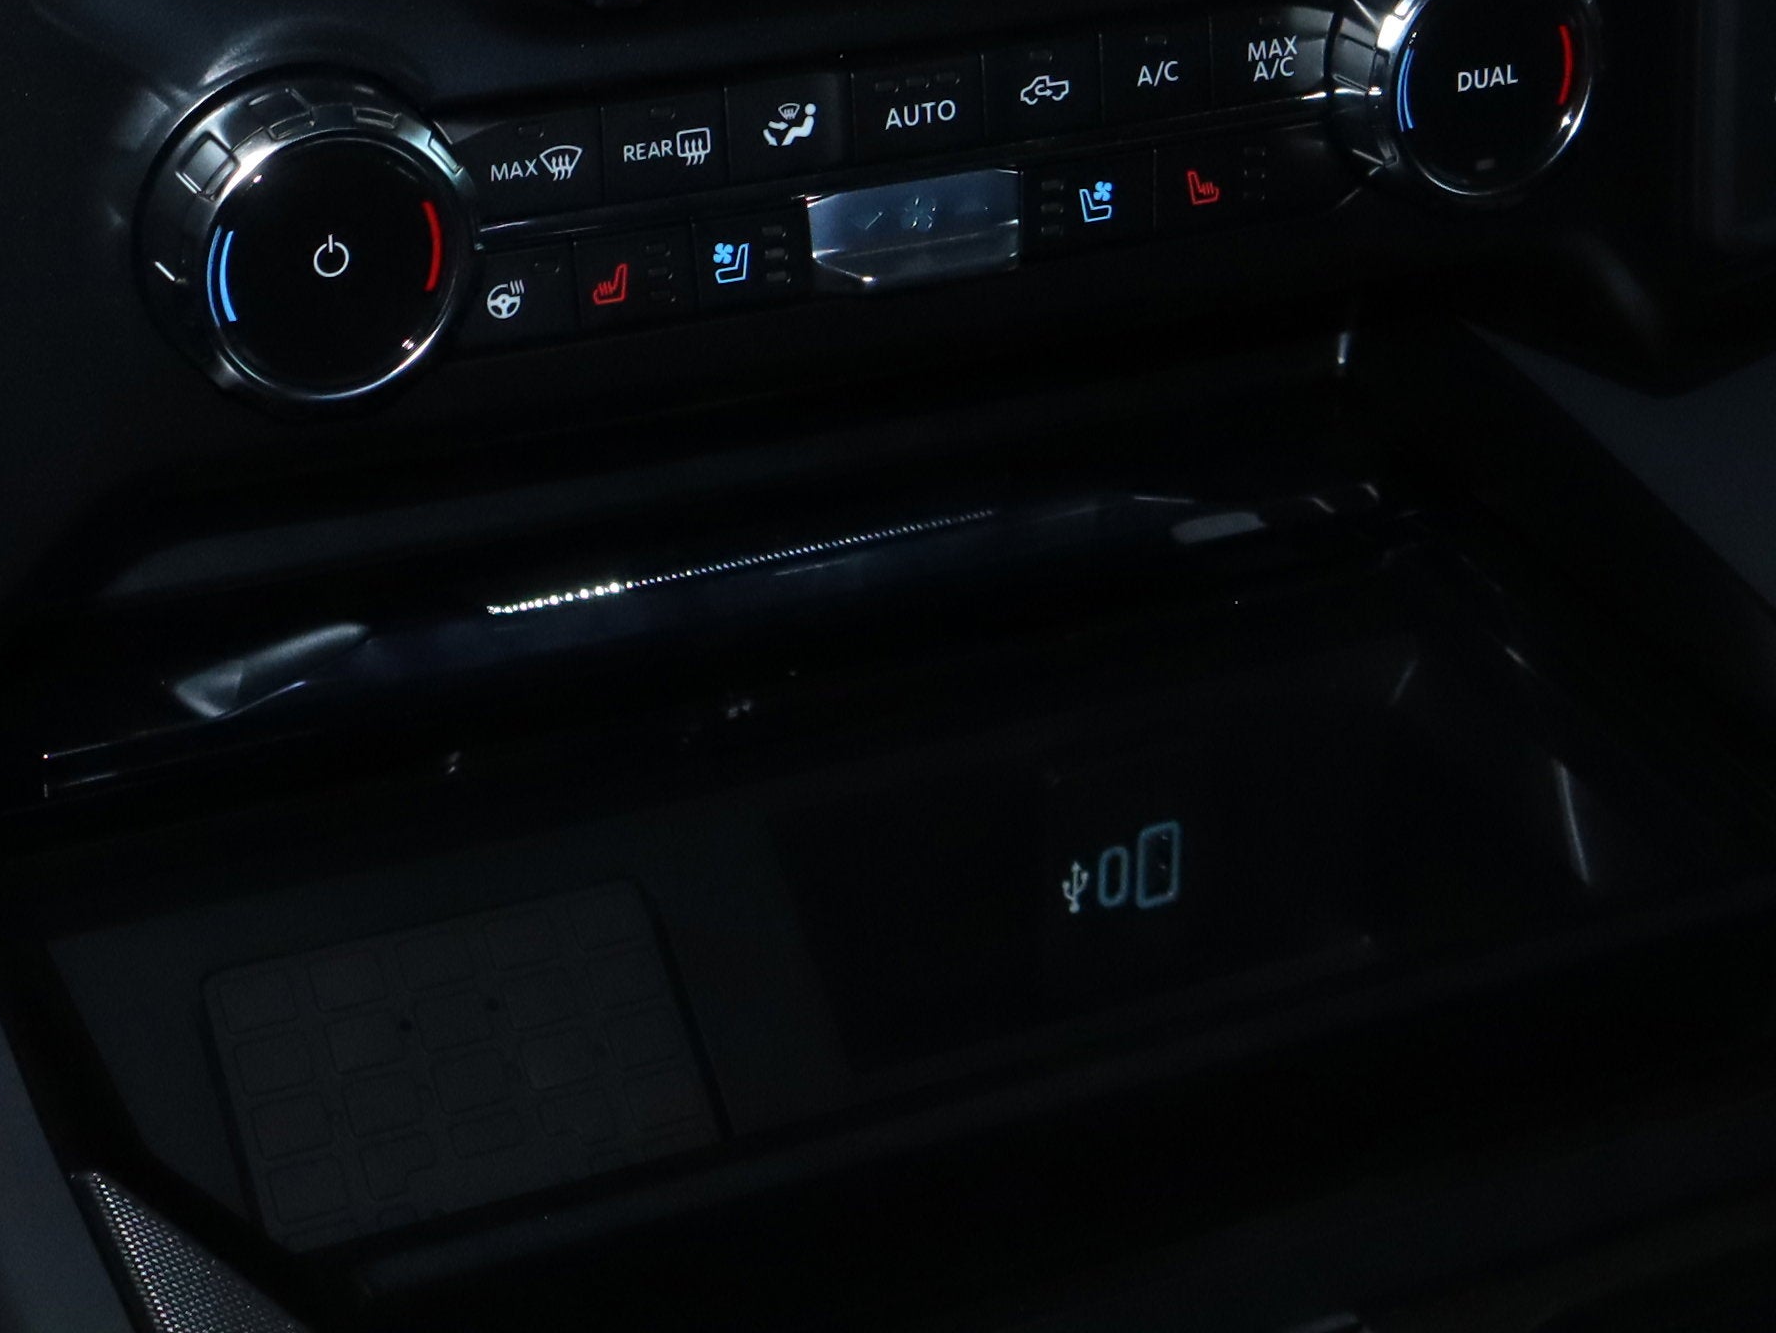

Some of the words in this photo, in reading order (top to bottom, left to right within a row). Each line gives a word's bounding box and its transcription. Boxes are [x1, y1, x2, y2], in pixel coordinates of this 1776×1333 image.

[1247, 35, 1298, 61] MAX
[1137, 60, 1179, 86] A/C
[1252, 56, 1295, 81] A/C
[1457, 64, 1518, 91] DUAL
[885, 99, 956, 130] AUTO
[624, 139, 672, 162] REAR
[490, 157, 538, 181] MAX
